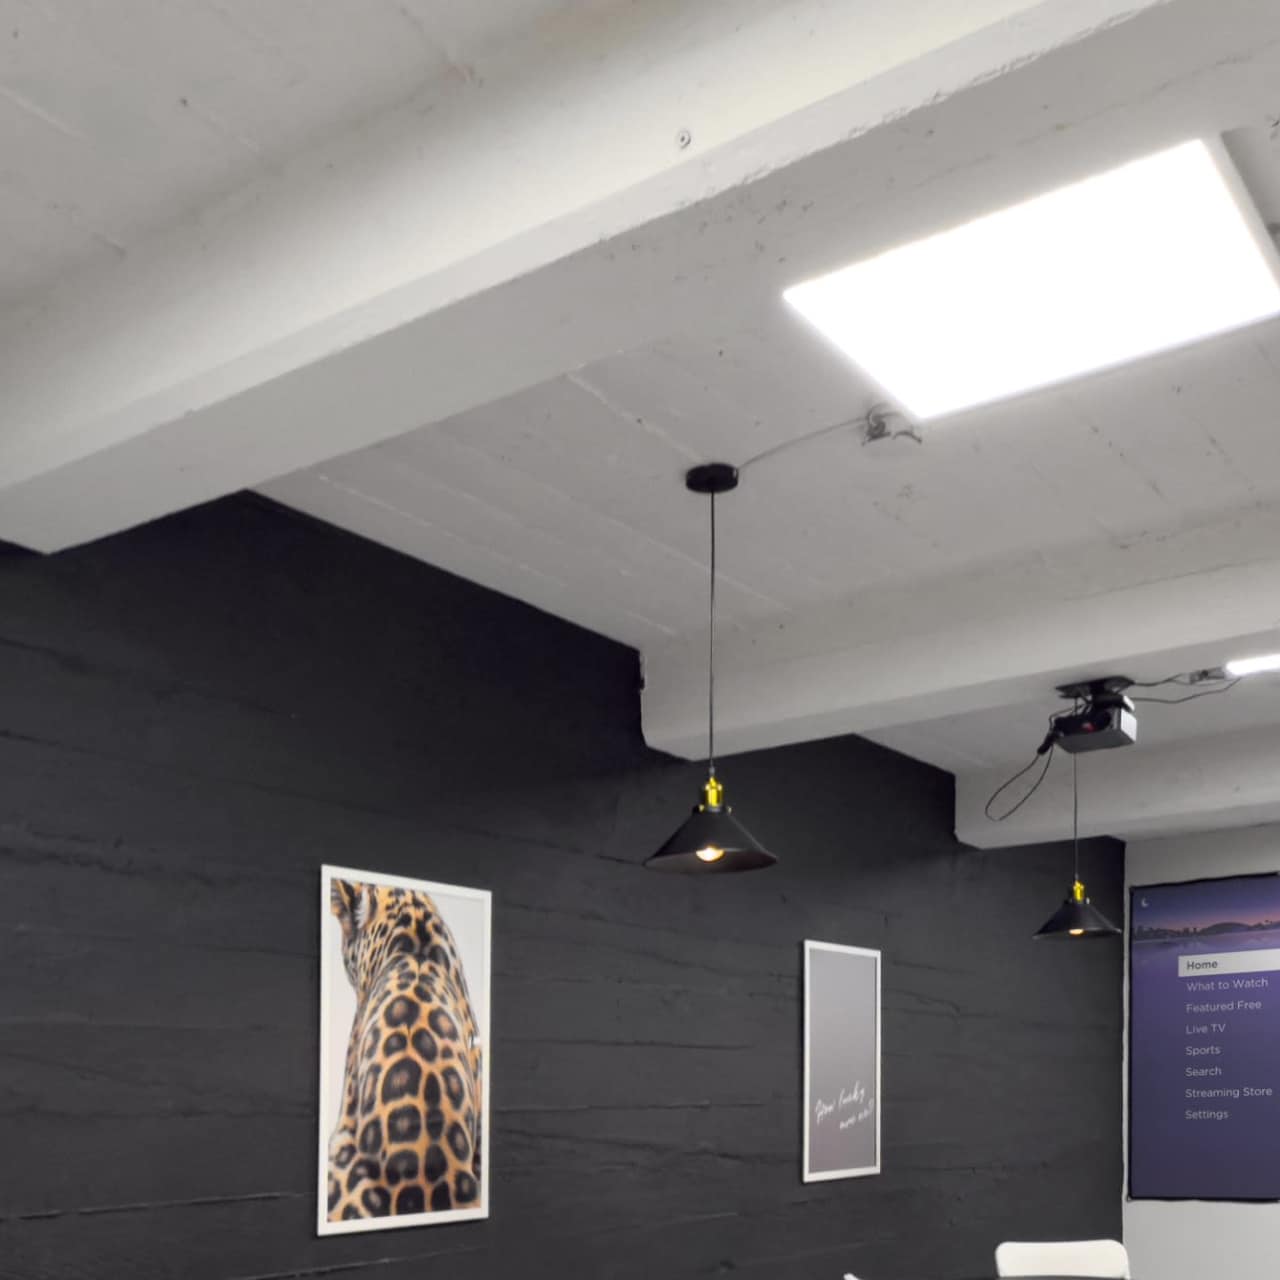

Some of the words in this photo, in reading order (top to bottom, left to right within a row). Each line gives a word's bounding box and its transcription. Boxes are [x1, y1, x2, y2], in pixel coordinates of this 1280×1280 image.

[1186, 959, 1218, 971] Home
[1187, 981, 1215, 992] What
[1218, 981, 1230, 990] to
[1232, 977, 1269, 989] Watch
[1186, 1001, 1235, 1013] Featured
[1237, 1000, 1262, 1011] Free
[1186, 1024, 1208, 1035] Live
[1210, 1023, 1226, 1034] TV
[1185, 1045, 1221, 1057] Sports
[1185, 1067, 1222, 1078] Search
[1185, 1088, 1240, 1099] Streaming
[1242, 1087, 1273, 1097] Store
[1185, 1110, 1229, 1121] Settings
